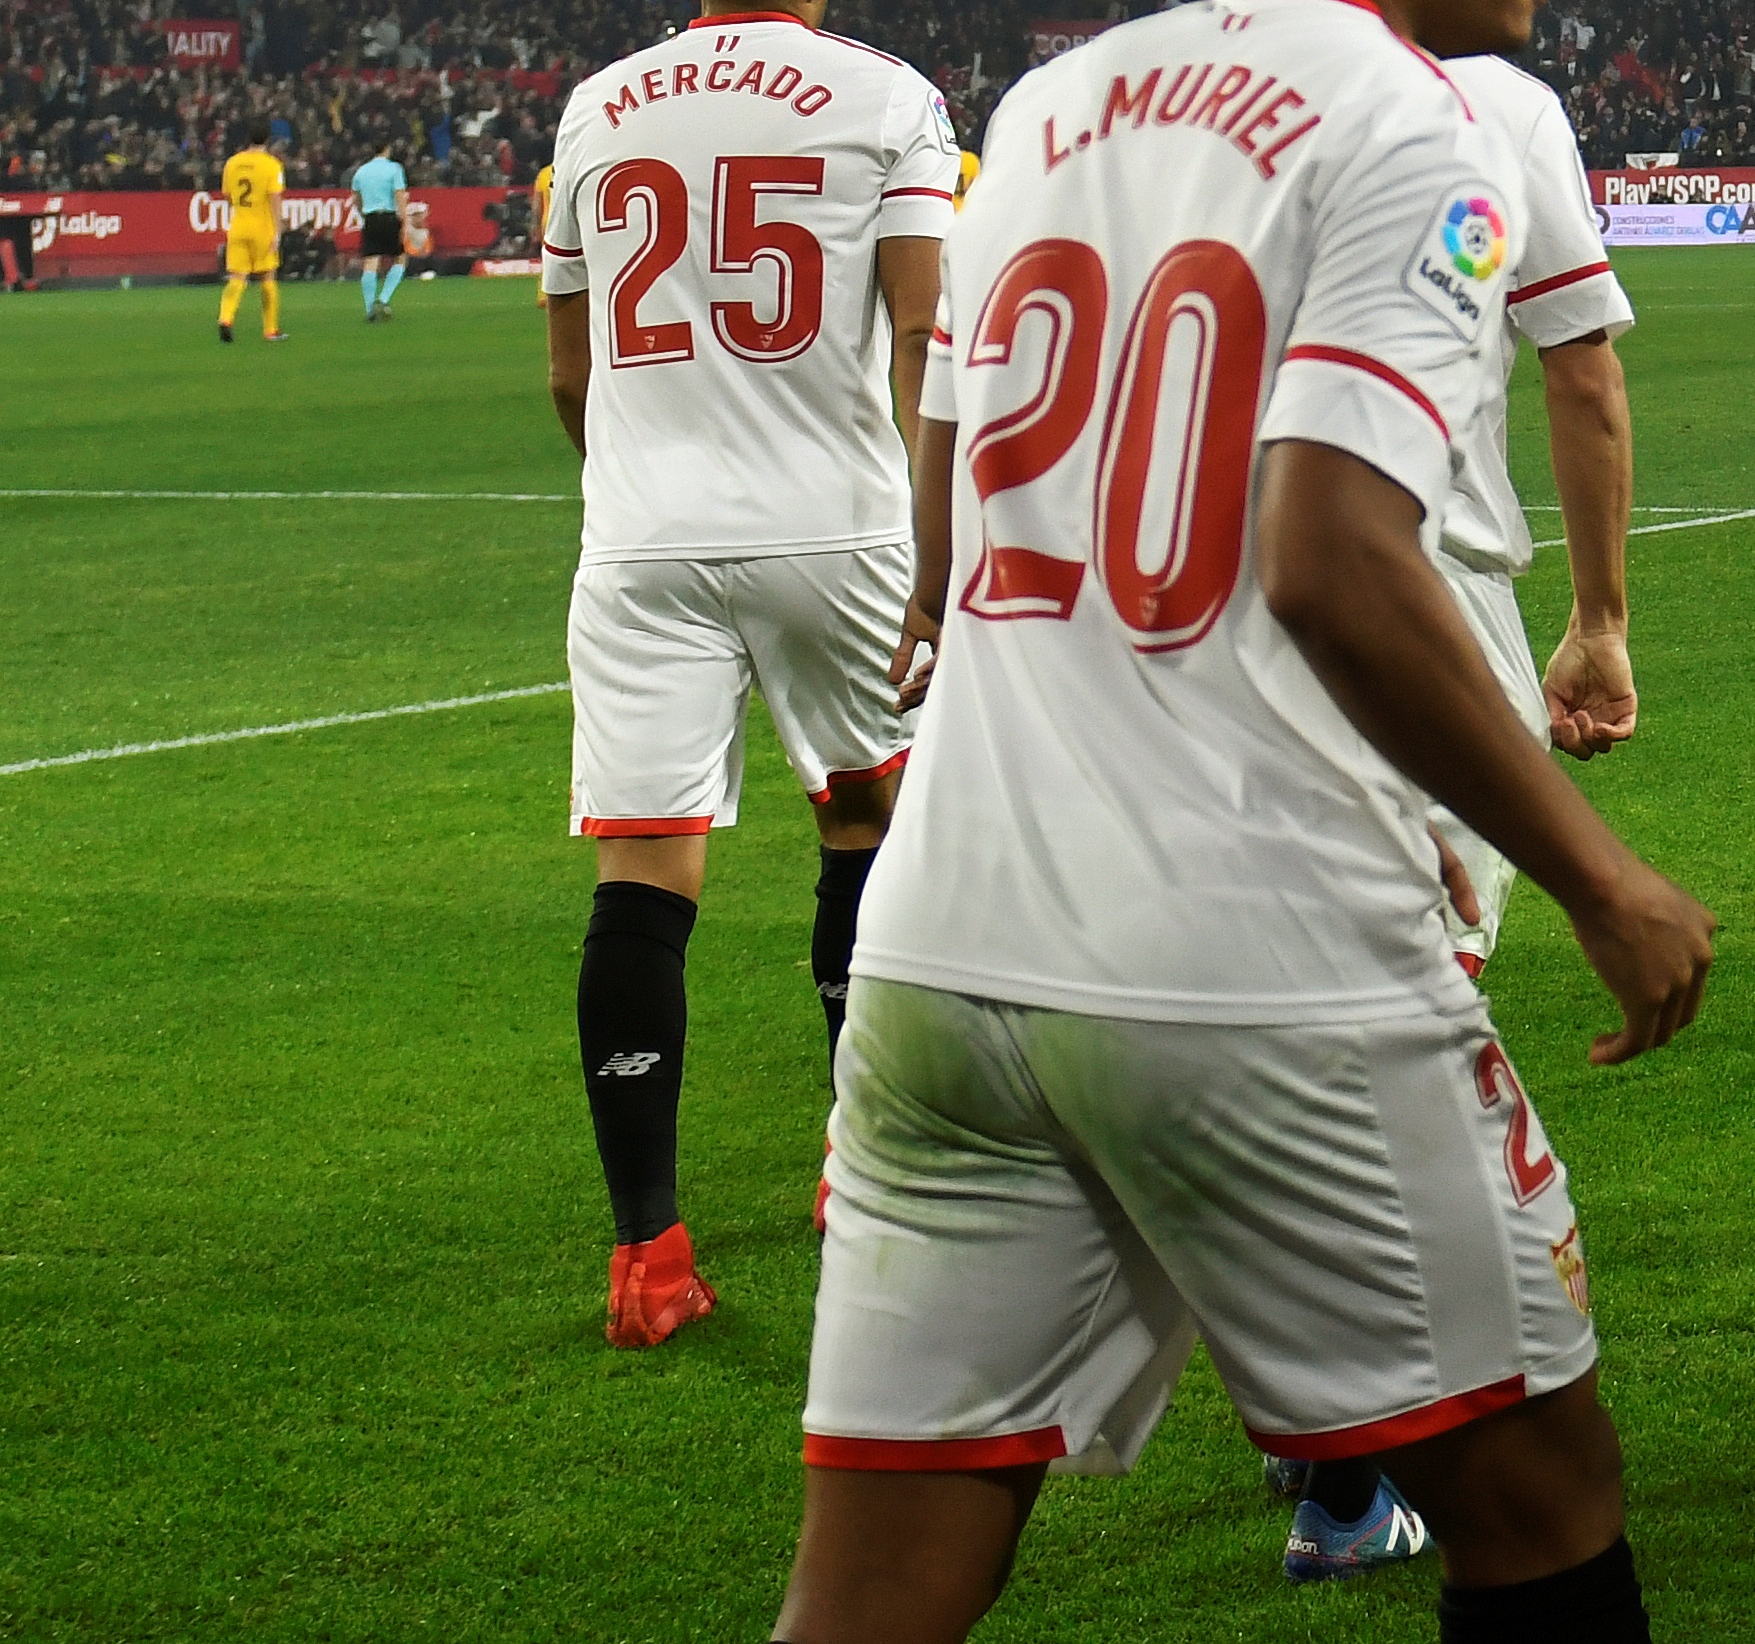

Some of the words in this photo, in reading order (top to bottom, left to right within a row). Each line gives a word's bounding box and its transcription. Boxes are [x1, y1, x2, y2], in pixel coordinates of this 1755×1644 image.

[602, 60, 833, 129] MERCADO
[1042, 62, 1322, 182] L.MURIEL
[60, 209, 121, 239] LaLiga
[189, 190, 342, 234] Crumpo
[238, 179, 253, 207] 2
[596, 156, 826, 370] 25
[959, 237, 1268, 654] 20
[1474, 1041, 1557, 1207] 2
